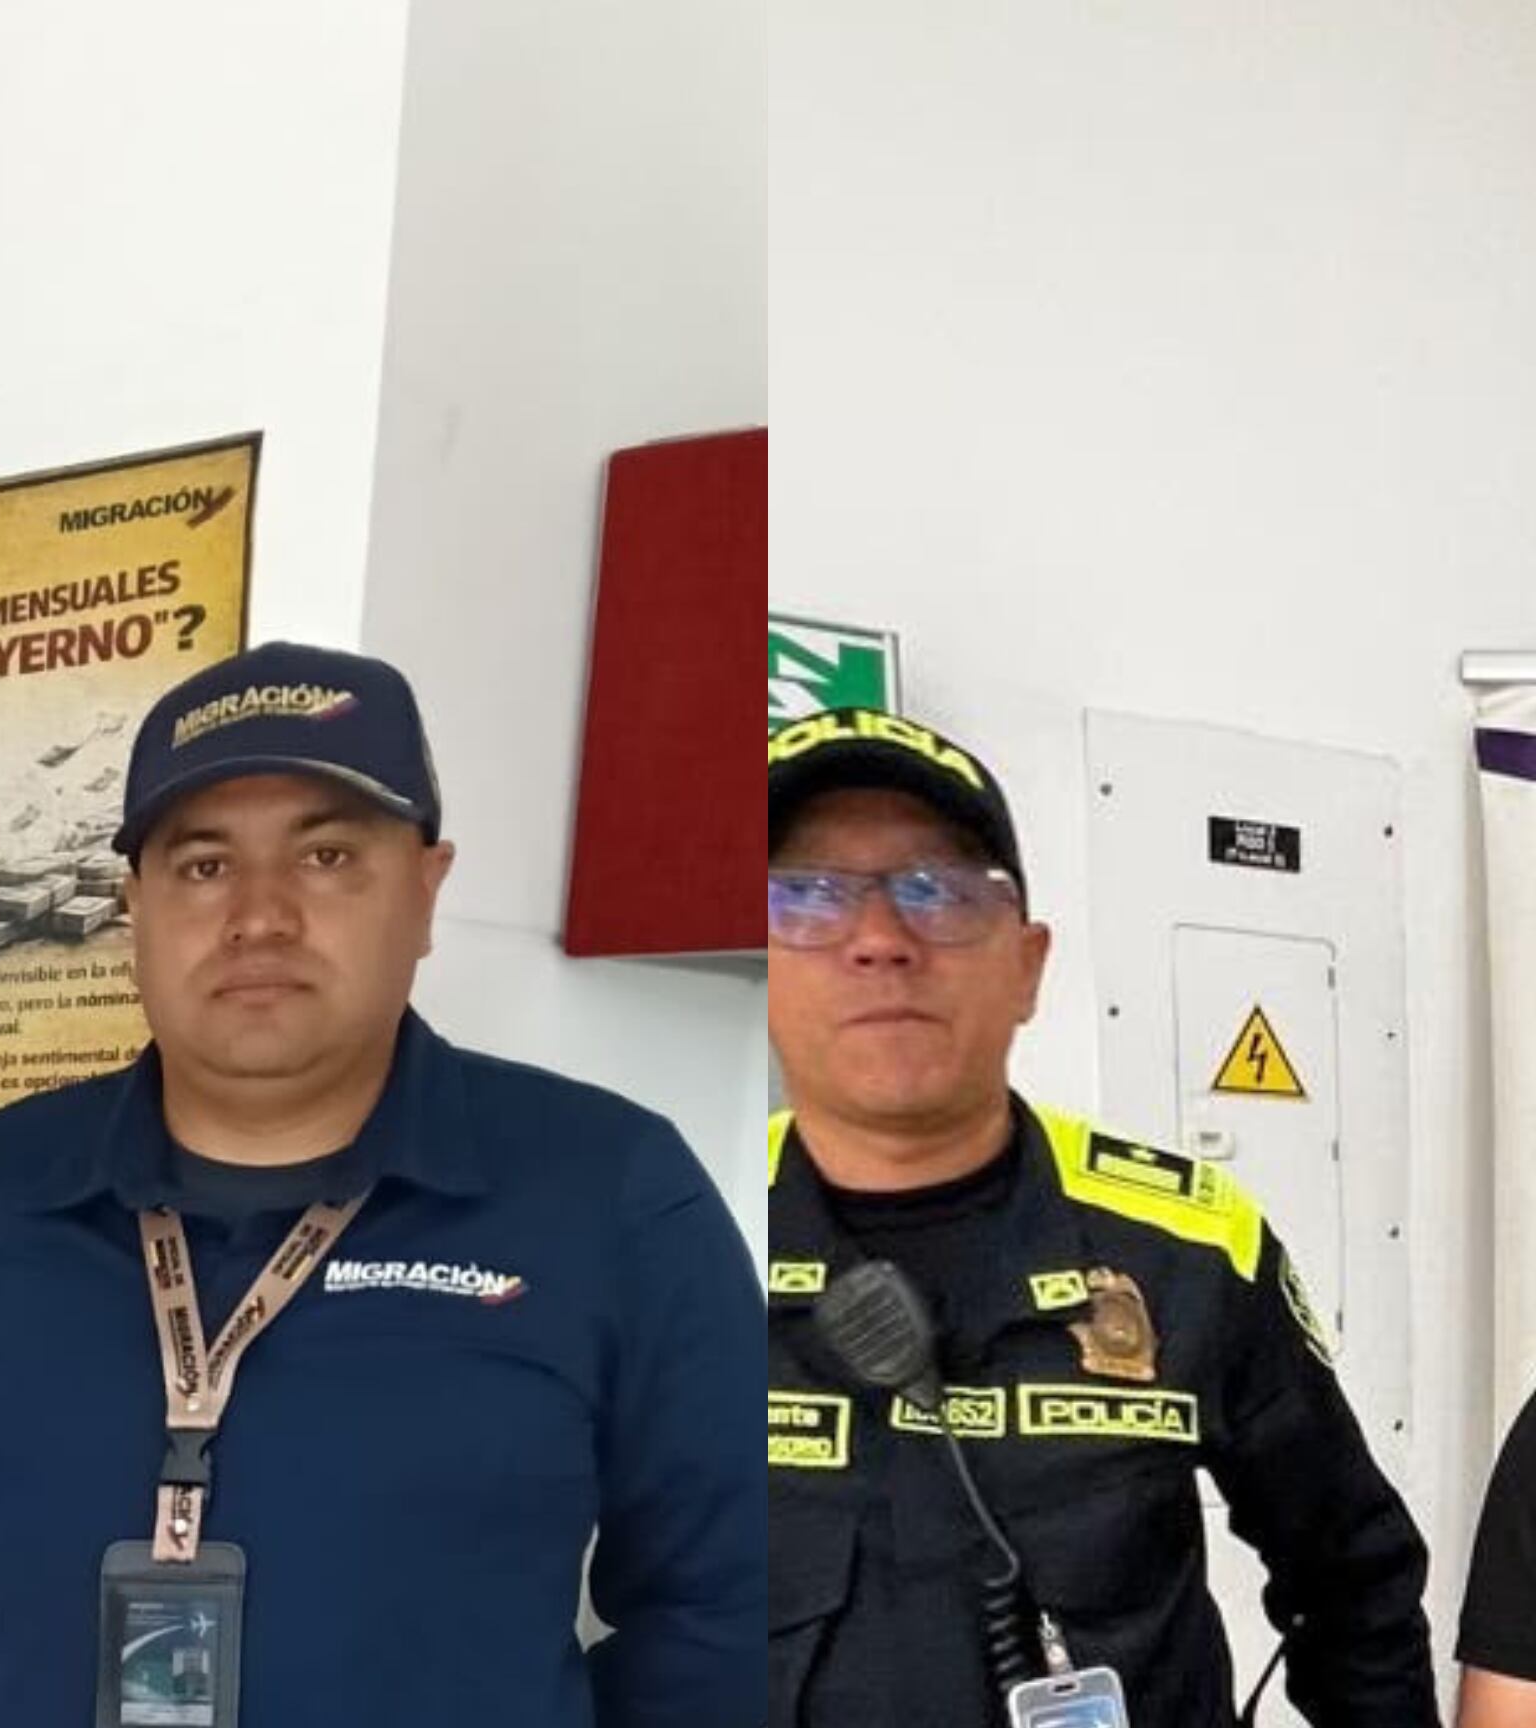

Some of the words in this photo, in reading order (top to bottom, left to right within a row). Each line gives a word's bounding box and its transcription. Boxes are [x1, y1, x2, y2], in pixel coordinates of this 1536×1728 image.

[59, 485, 214, 534] MIGRACIÓN
[172, 682, 336, 742] MIGRACIÓN
[66, 967, 87, 980] en
[90, 961, 107, 978] la
[18, 995, 54, 1014] pero
[57, 991, 72, 1009] la
[75, 990, 141, 1009] nómina
[21, 1044, 119, 1064] sentimental
[0, 1075, 19, 1089] es
[324, 1259, 506, 1297] MIGRACIÓN
[1040, 1397, 1183, 1433] POLICÍA
